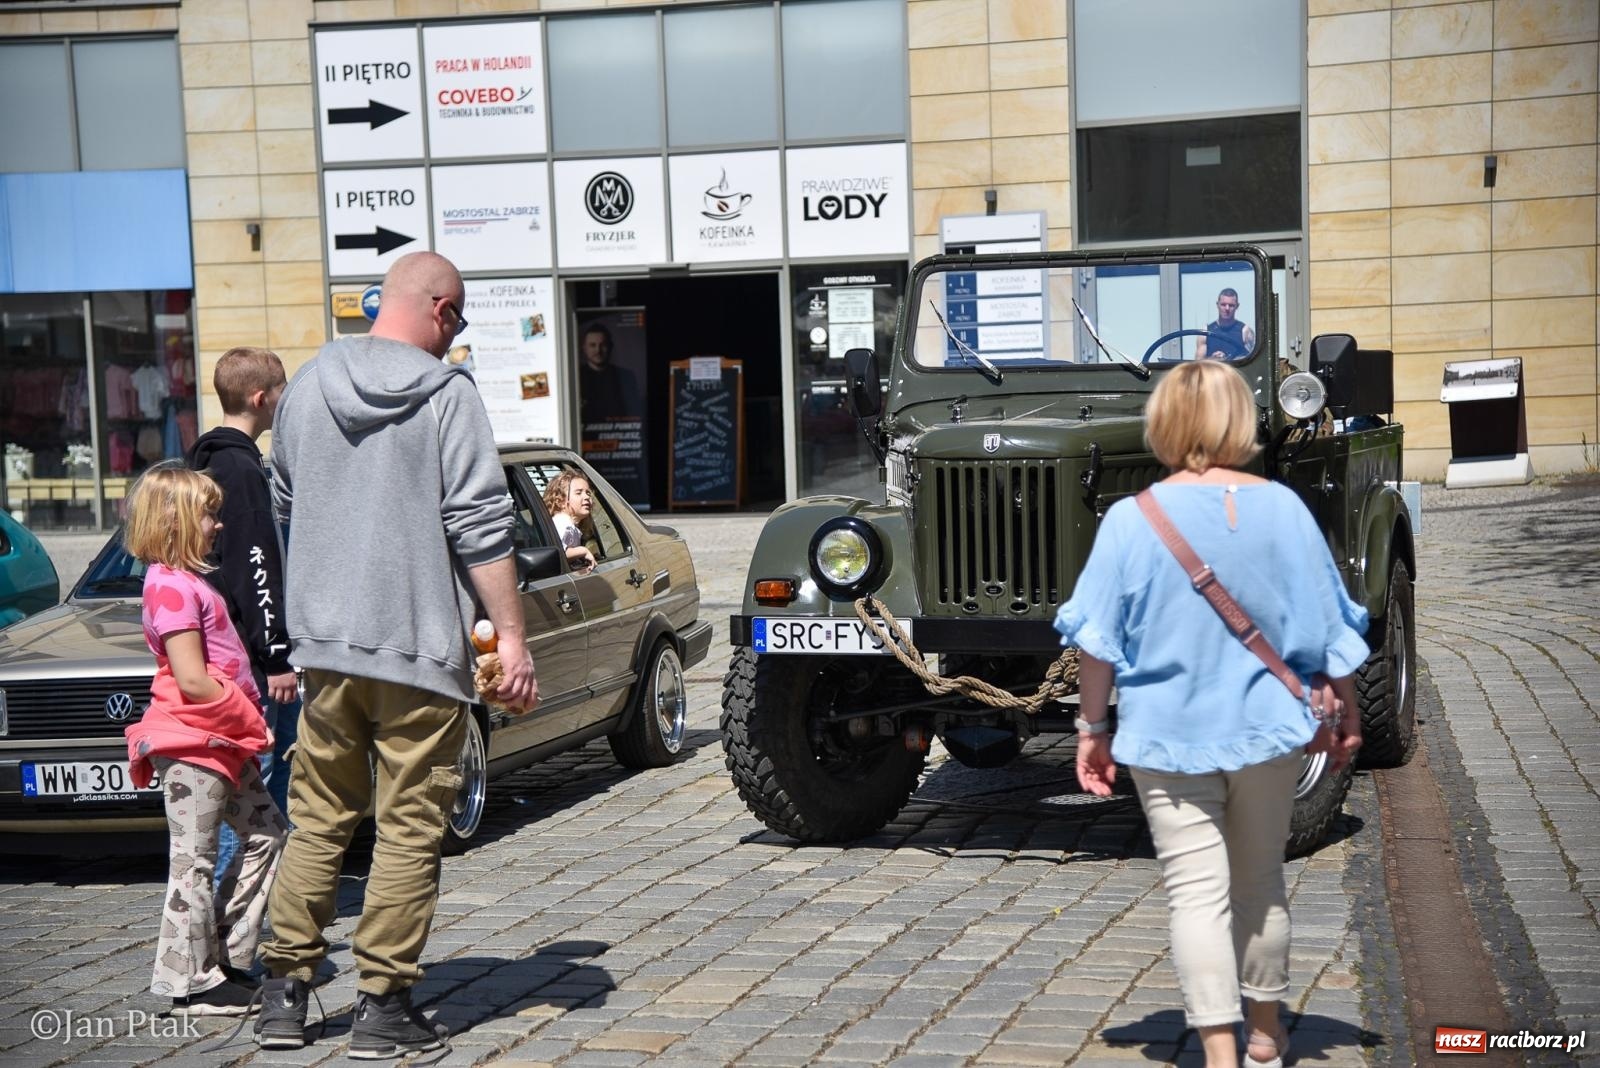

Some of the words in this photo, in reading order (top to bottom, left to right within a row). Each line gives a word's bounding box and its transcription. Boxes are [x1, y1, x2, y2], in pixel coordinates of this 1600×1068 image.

[435, 58, 469, 74] PRACA
[470, 57, 481, 72] W
[483, 55, 532, 71] HOLANDII
[325, 65, 336, 82] II
[343, 62, 411, 84] PIĘTRO
[438, 87, 515, 106] COVEBO
[439, 107, 474, 119] TECHNIKA
[475, 107, 481, 118] &
[482, 104, 535, 117] BUDOWNICTWO
[801, 177, 889, 193] PRAWDZIWE
[335, 192, 340, 208] I
[347, 189, 415, 211] PIĘTRO
[803, 193, 888, 221] LODY
[443, 207, 501, 219] MOSTOSTAL
[502, 206, 540, 217] ZABRZE
[585, 230, 636, 243] FRYZJER
[699, 225, 755, 240] KOFEINKA
[490, 286, 536, 296] KOFEINKA
[755, 639, 766, 648] PL
[772, 622, 824, 650] SRC
[41, 765, 78, 793] WW
[25, 783, 36, 792] PL
